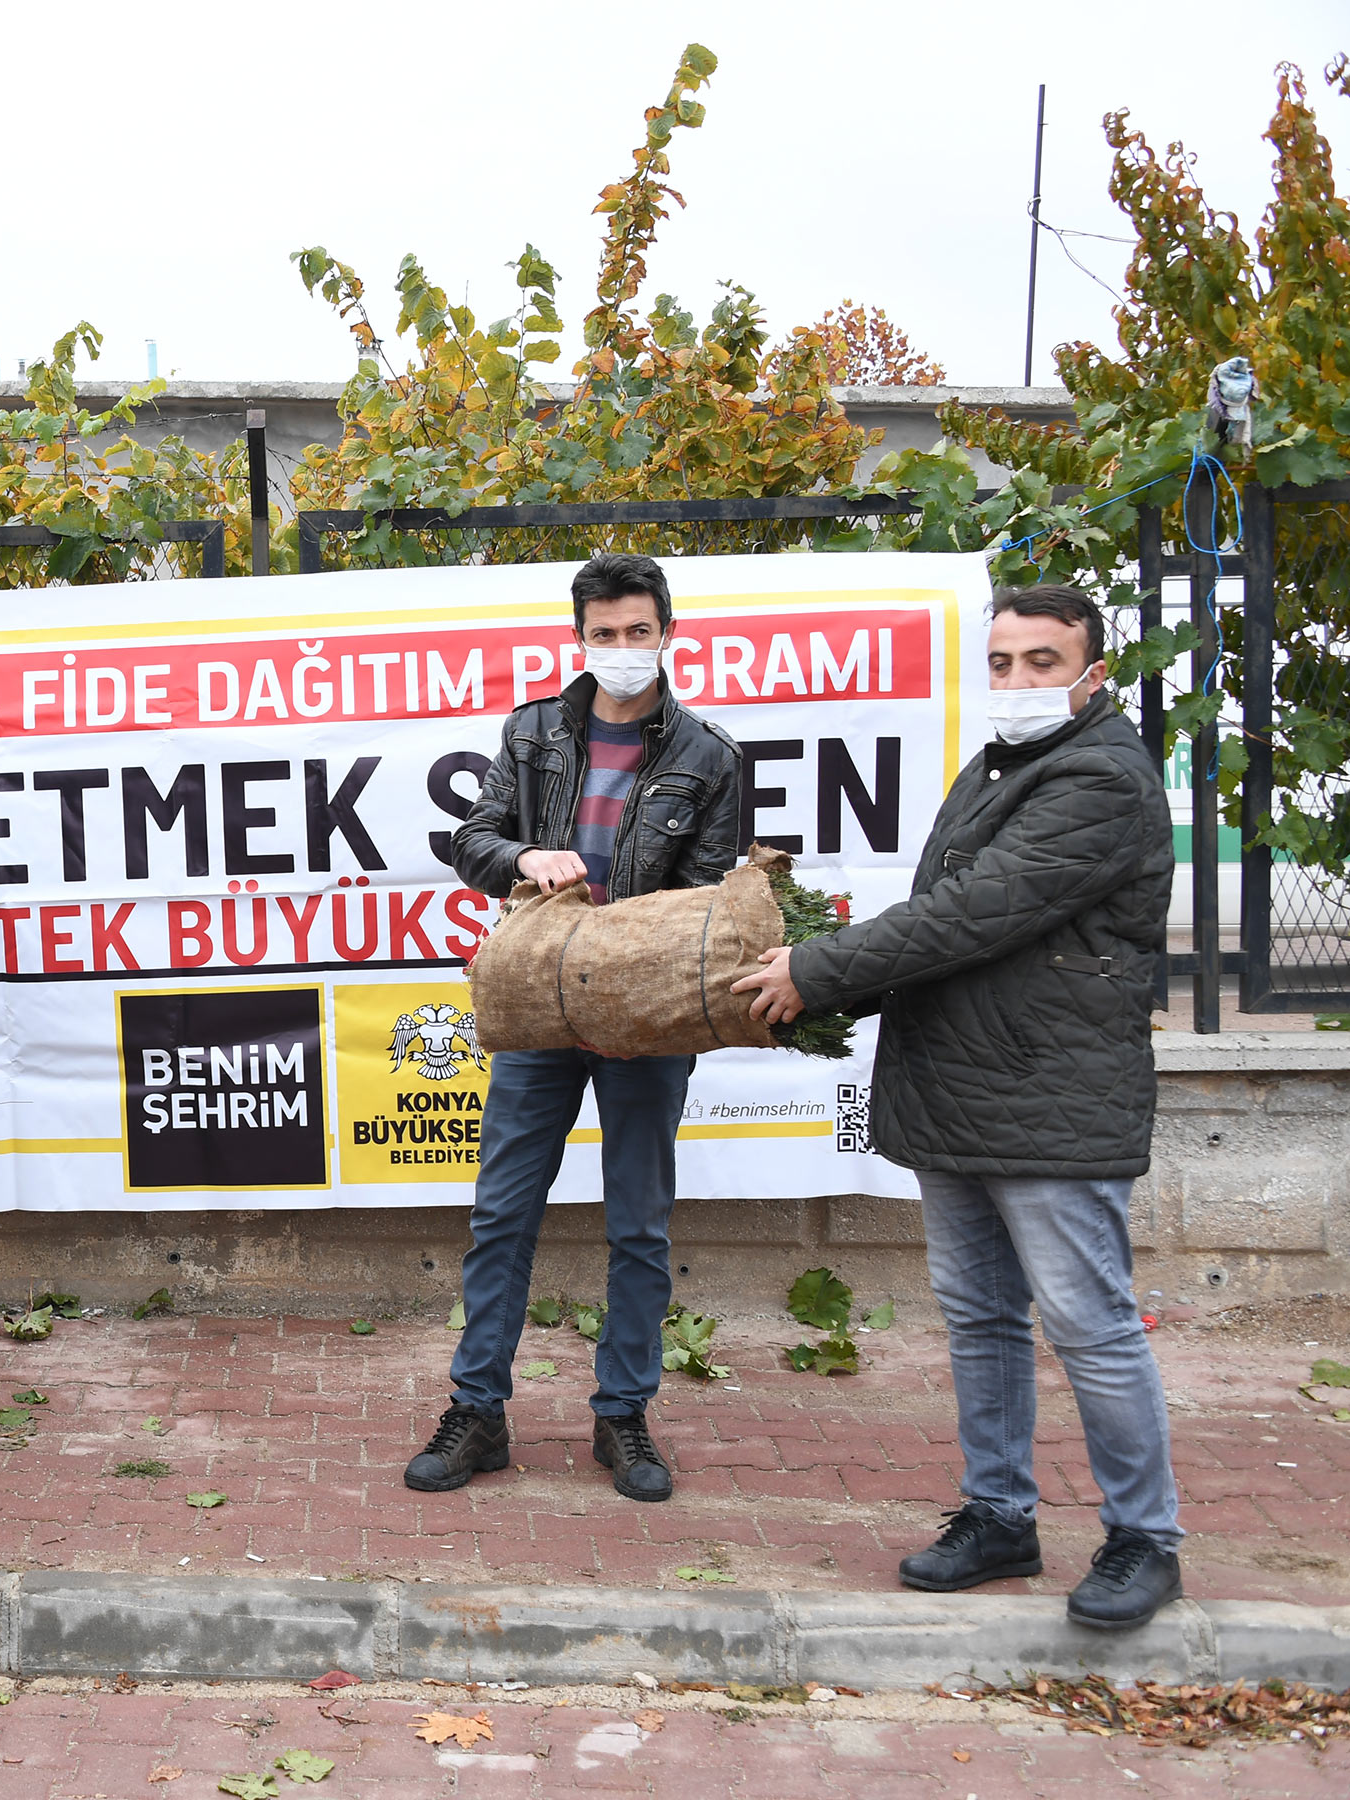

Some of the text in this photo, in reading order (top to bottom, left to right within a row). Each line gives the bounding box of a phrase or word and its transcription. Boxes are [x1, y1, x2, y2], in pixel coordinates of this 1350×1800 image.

[22, 652, 172, 731] FİDE
[197, 638, 484, 722] DAĞITIM
[396, 1091, 483, 1113] KONYA
[709, 1100, 826, 1118] #benimsehrim
